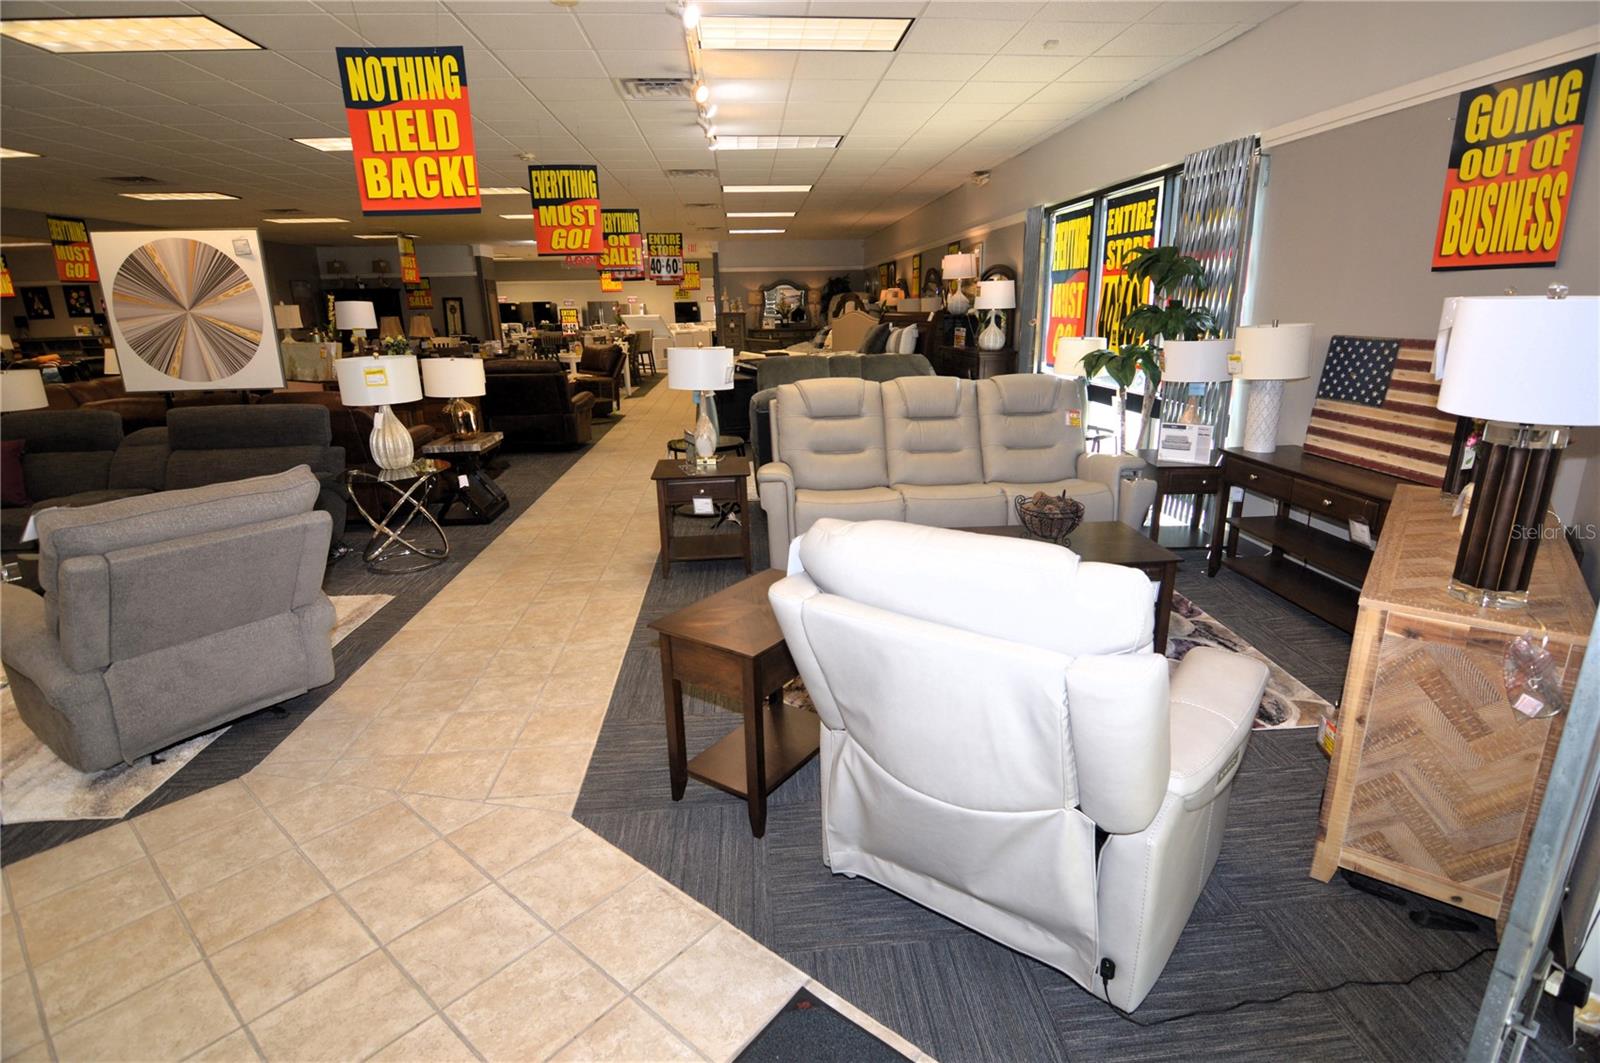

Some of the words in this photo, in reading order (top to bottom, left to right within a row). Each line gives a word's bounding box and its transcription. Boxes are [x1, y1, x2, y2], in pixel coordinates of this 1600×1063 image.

[345, 54, 462, 102] NOTHING
[1465, 69, 1583, 143] GOING
[367, 108, 460, 152] HELD
[1459, 142, 1526, 181] OUT
[1531, 130, 1573, 170] OF
[361, 154, 477, 199] BACK!
[531, 169, 598, 199] EVERYTHING
[539, 206, 597, 227] MUST
[601, 212, 639, 234] ERYTHING
[1106, 198, 1156, 237] ENTIRE
[1441, 171, 1568, 256] BUSINESS
[551, 229, 592, 250] GO!
[608, 234, 630, 247] ON
[648, 233, 681, 246] ENTIRE
[649, 245, 681, 256] STORE
[55, 245, 91, 261] MUST
[600, 246, 642, 266] SALE!
[65, 263, 91, 278] GO!
[1052, 283, 1085, 319] MUST
